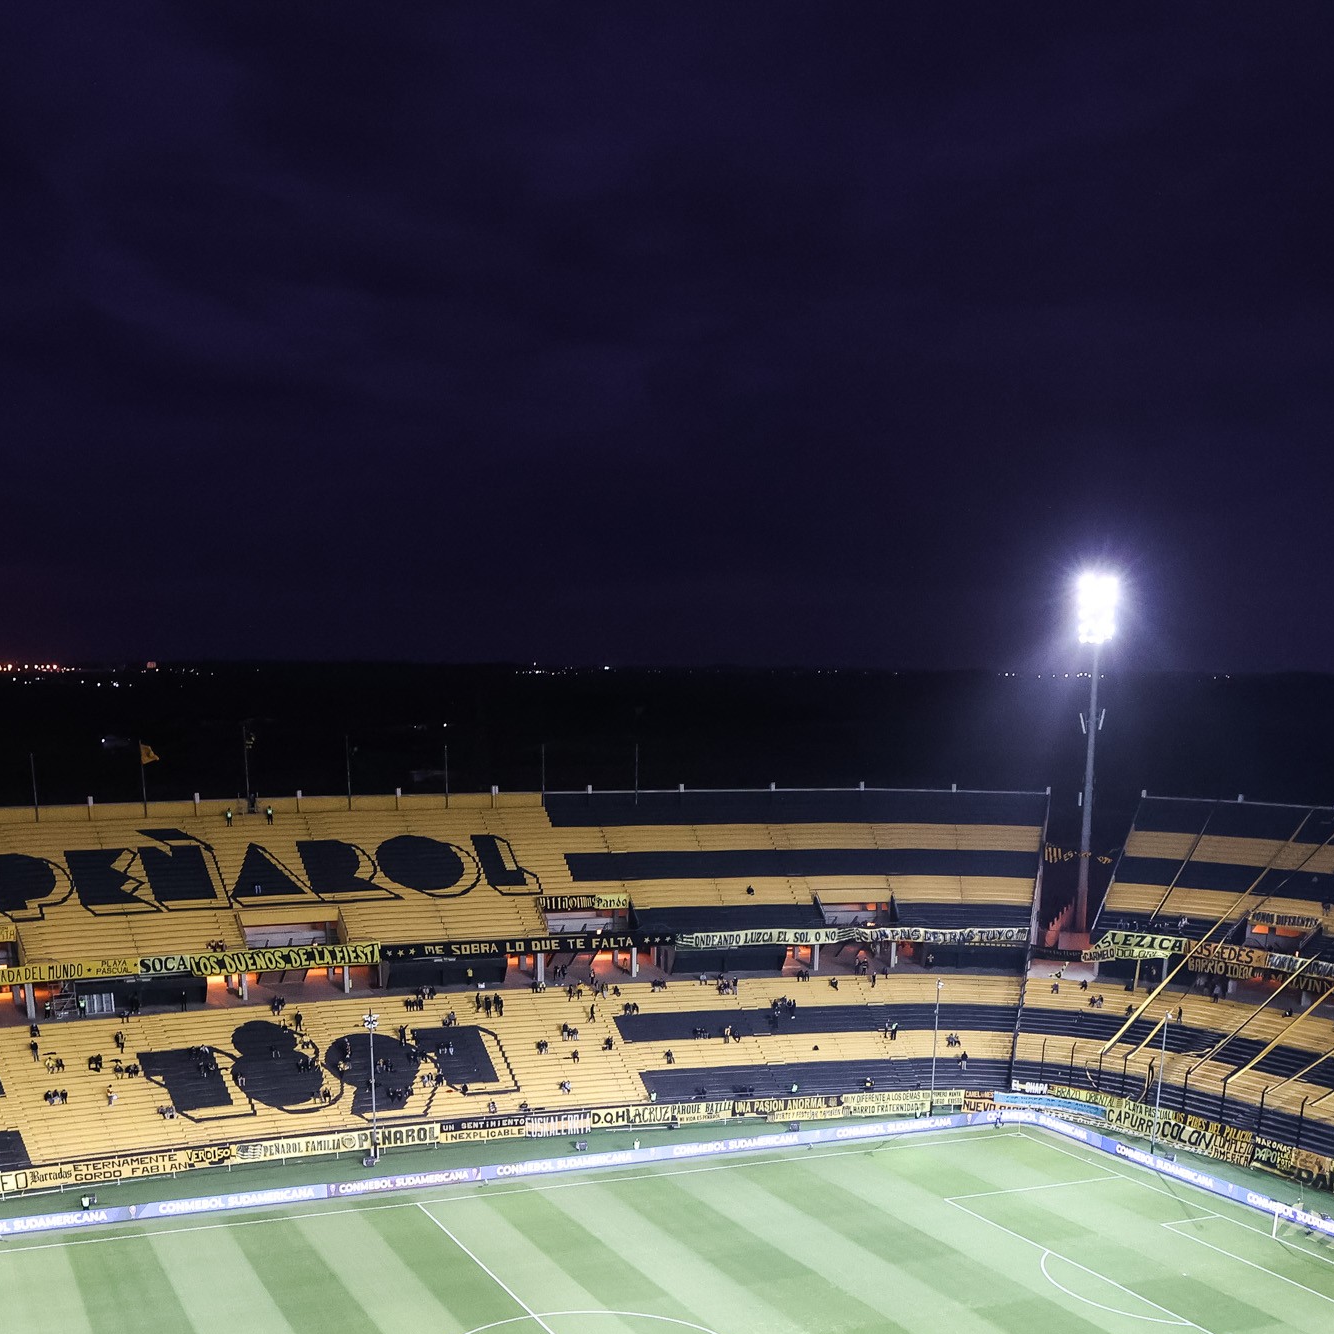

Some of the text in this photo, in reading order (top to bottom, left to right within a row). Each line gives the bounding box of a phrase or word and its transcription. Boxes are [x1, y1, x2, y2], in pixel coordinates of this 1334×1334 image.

[424, 936, 633, 956] ME SOBRA LO QUE TE FALTA
[694, 928, 837, 947] ONDEANDO LUZCA EL SOL O NO
[1111, 932, 1184, 953] LEZICA
[100, 959, 128, 968] PLAYA
[139, 955, 190, 974] SOCA
[191, 943, 381, 976] LOS DE LA FIESTA
[1083, 948, 1115, 962] CARMELO
[24, 965, 46, 982] DEL
[48, 963, 84, 981] MUNDO
[95, 966, 133, 976] PASCUAL
[1188, 957, 1226, 976] BARRIO
[1227, 961, 1253, 980] IDEAL
[137, 1020, 519, 1122] 1891
[1012, 1079, 1049, 1095] EL CHAPA
[1056, 1086, 1080, 1100] BRAZO
[735, 1097, 827, 1113] UNA PASION ANORMAL
[856, 1091, 921, 1104] DIFERENTE A LOS DEMAS
[962, 1099, 996, 1112] NUEVO
[626, 1105, 671, 1124] LACRUZ
[672, 1100, 732, 1116] PARQUE BATLLE
[852, 1103, 876, 1116] BARRIO
[876, 1101, 919, 1114] FRATERNIDAD
[1124, 1098, 1144, 1115] PLAYA
[1144, 1105, 1172, 1121] PASCUAL
[442, 1123, 455, 1132] UN
[525, 1113, 592, 1138] EUSKALERRIA
[1107, 1108, 1161, 1135] CAPURRO
[1160, 1121, 1214, 1150] COLON
[1208, 1121, 1222, 1134] DEL
[1224, 1125, 1253, 1143] PALACIO
[185, 1145, 238, 1164] VERDISOL
[263, 1138, 342, 1157] PEÑAROL FAMILIA
[1253, 1147, 1277, 1162] PAPO
[73, 1154, 178, 1173] ETERNAMENTE
[74, 1161, 189, 1182] GORDO FABIAN
[29, 1168, 73, 1184] Barradas
[339, 1170, 469, 1194] CONMEBOL SUDAMERICANA
